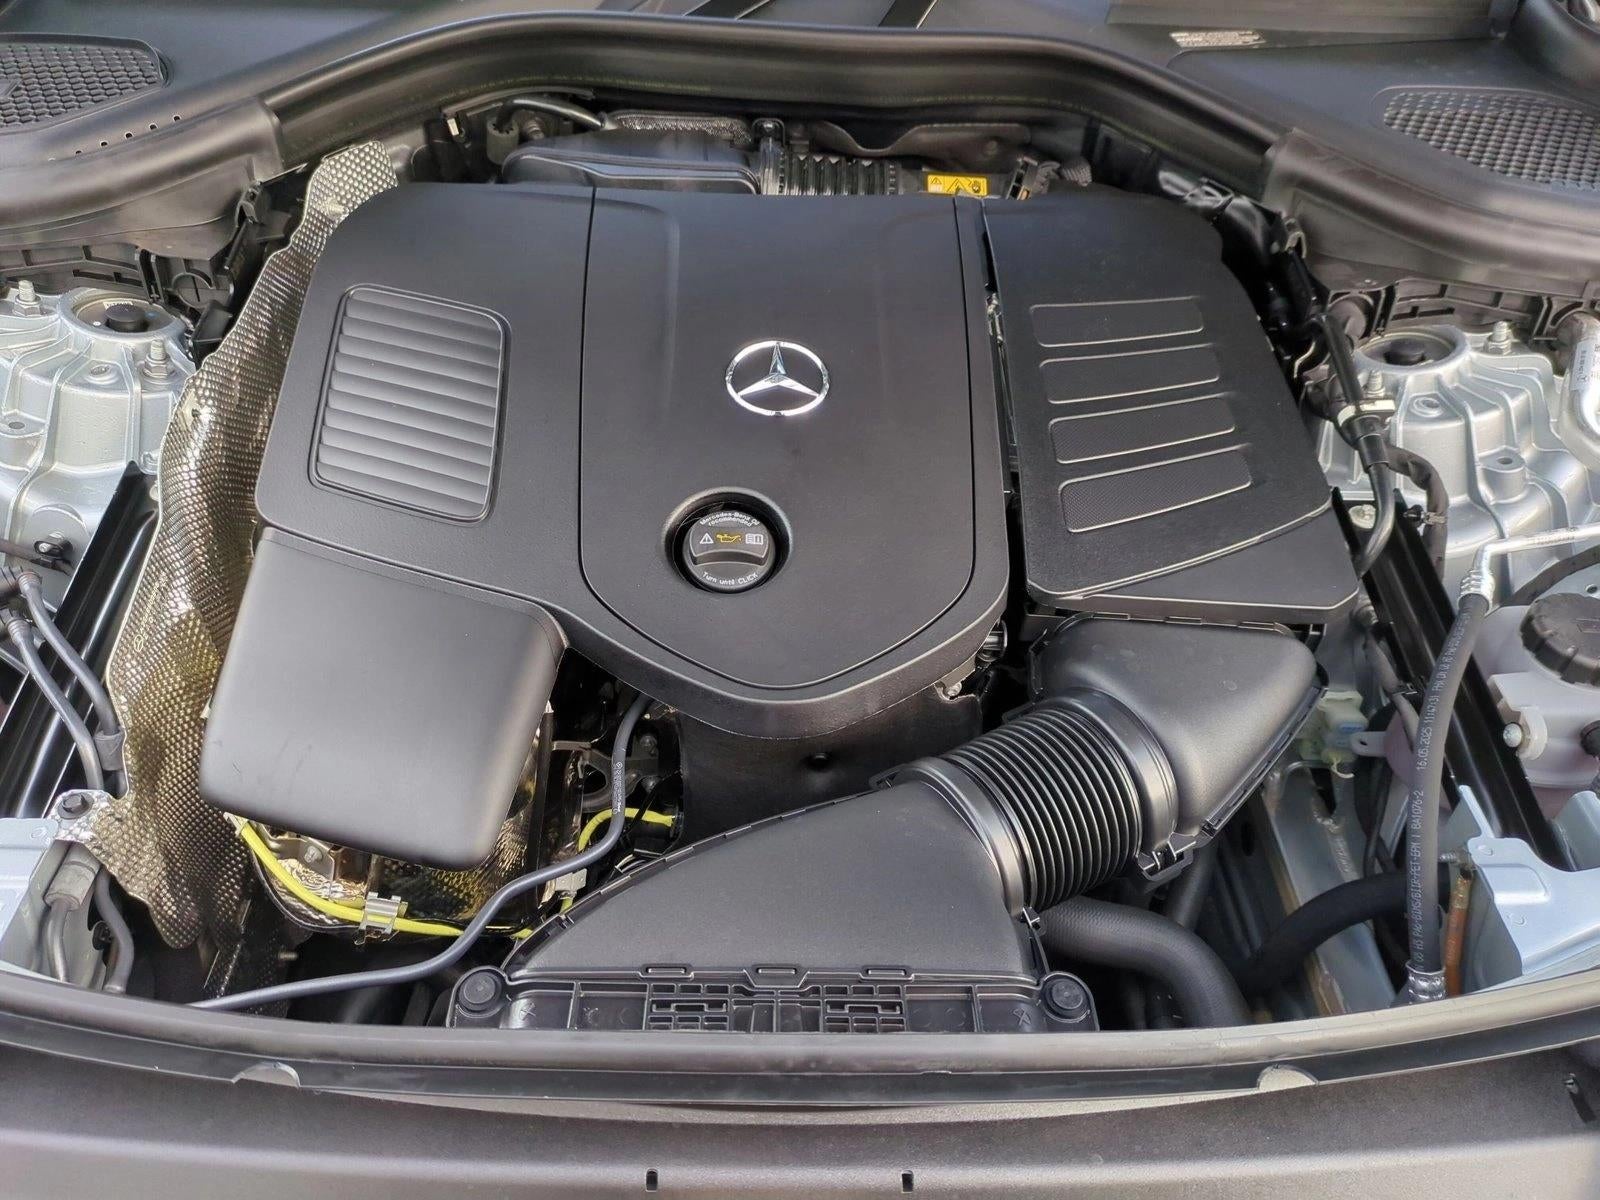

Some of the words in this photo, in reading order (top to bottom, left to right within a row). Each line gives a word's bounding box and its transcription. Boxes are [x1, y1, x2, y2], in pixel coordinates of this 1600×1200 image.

[700, 511, 751, 525] Mercedes-Benz
[708, 517, 753, 527] recommended
[702, 571, 717, 584] Turn
[719, 577, 735, 585] until
[738, 572, 758, 584] CLICK
